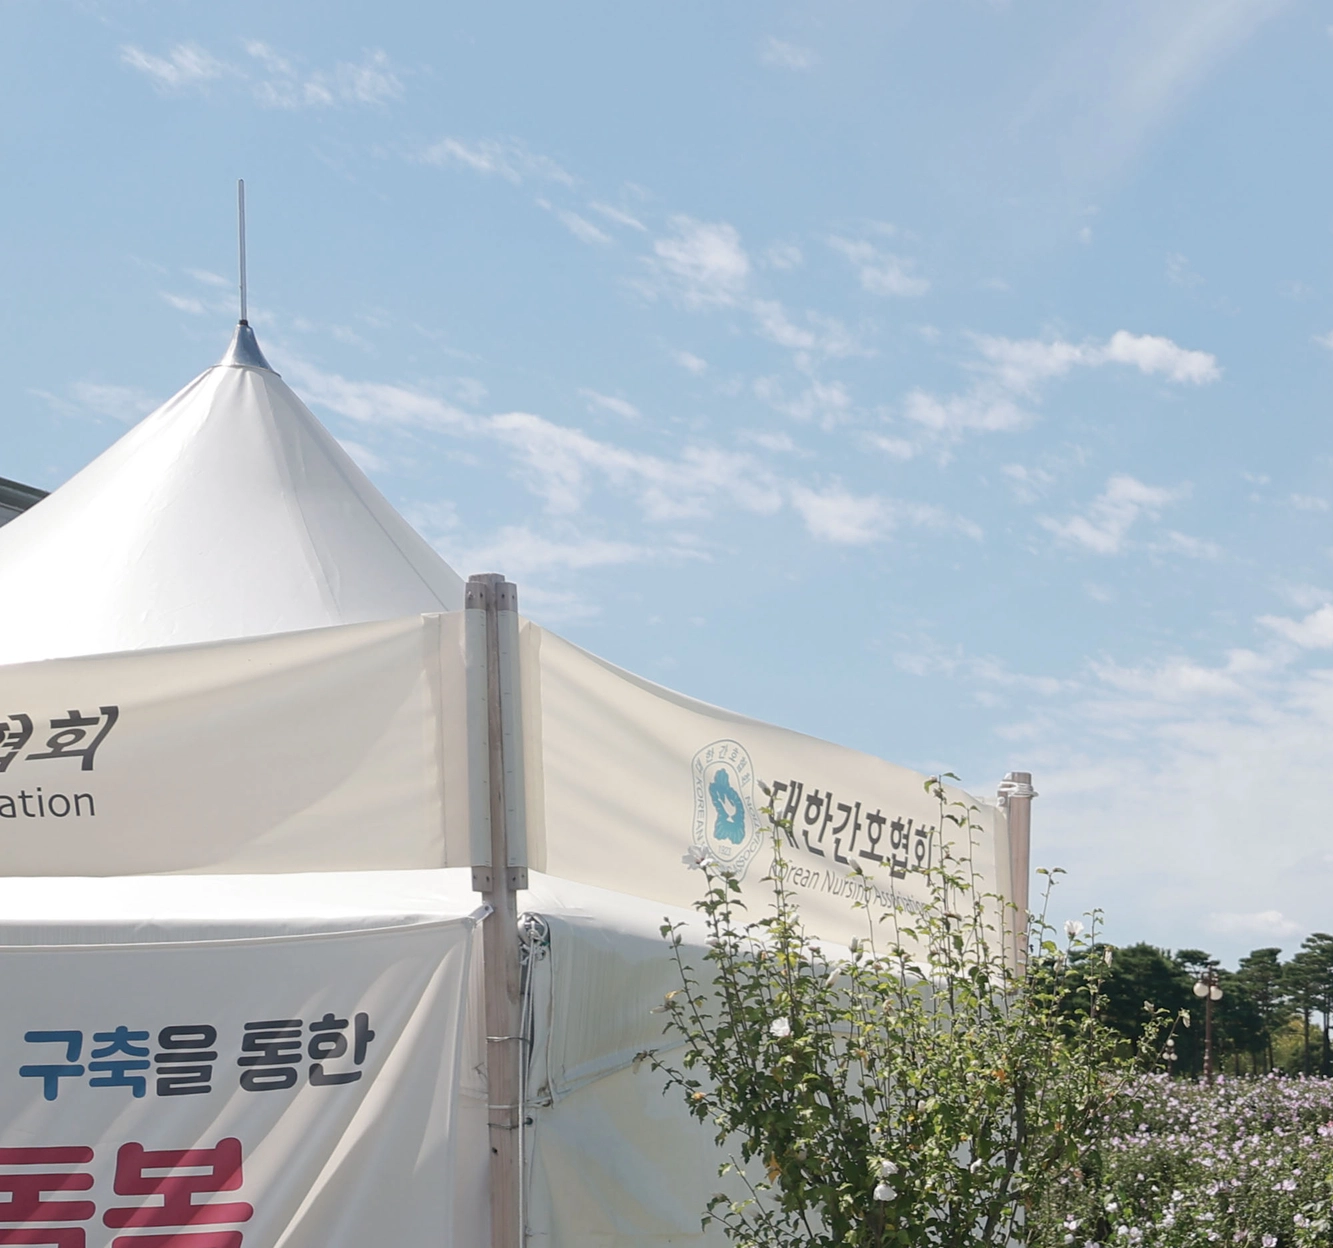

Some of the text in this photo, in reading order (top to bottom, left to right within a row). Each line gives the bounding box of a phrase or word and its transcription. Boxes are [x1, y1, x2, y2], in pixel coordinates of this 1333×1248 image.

[768, 780, 935, 887] 대한간호협회
[19, 1011, 375, 1101] 구축을 통한
